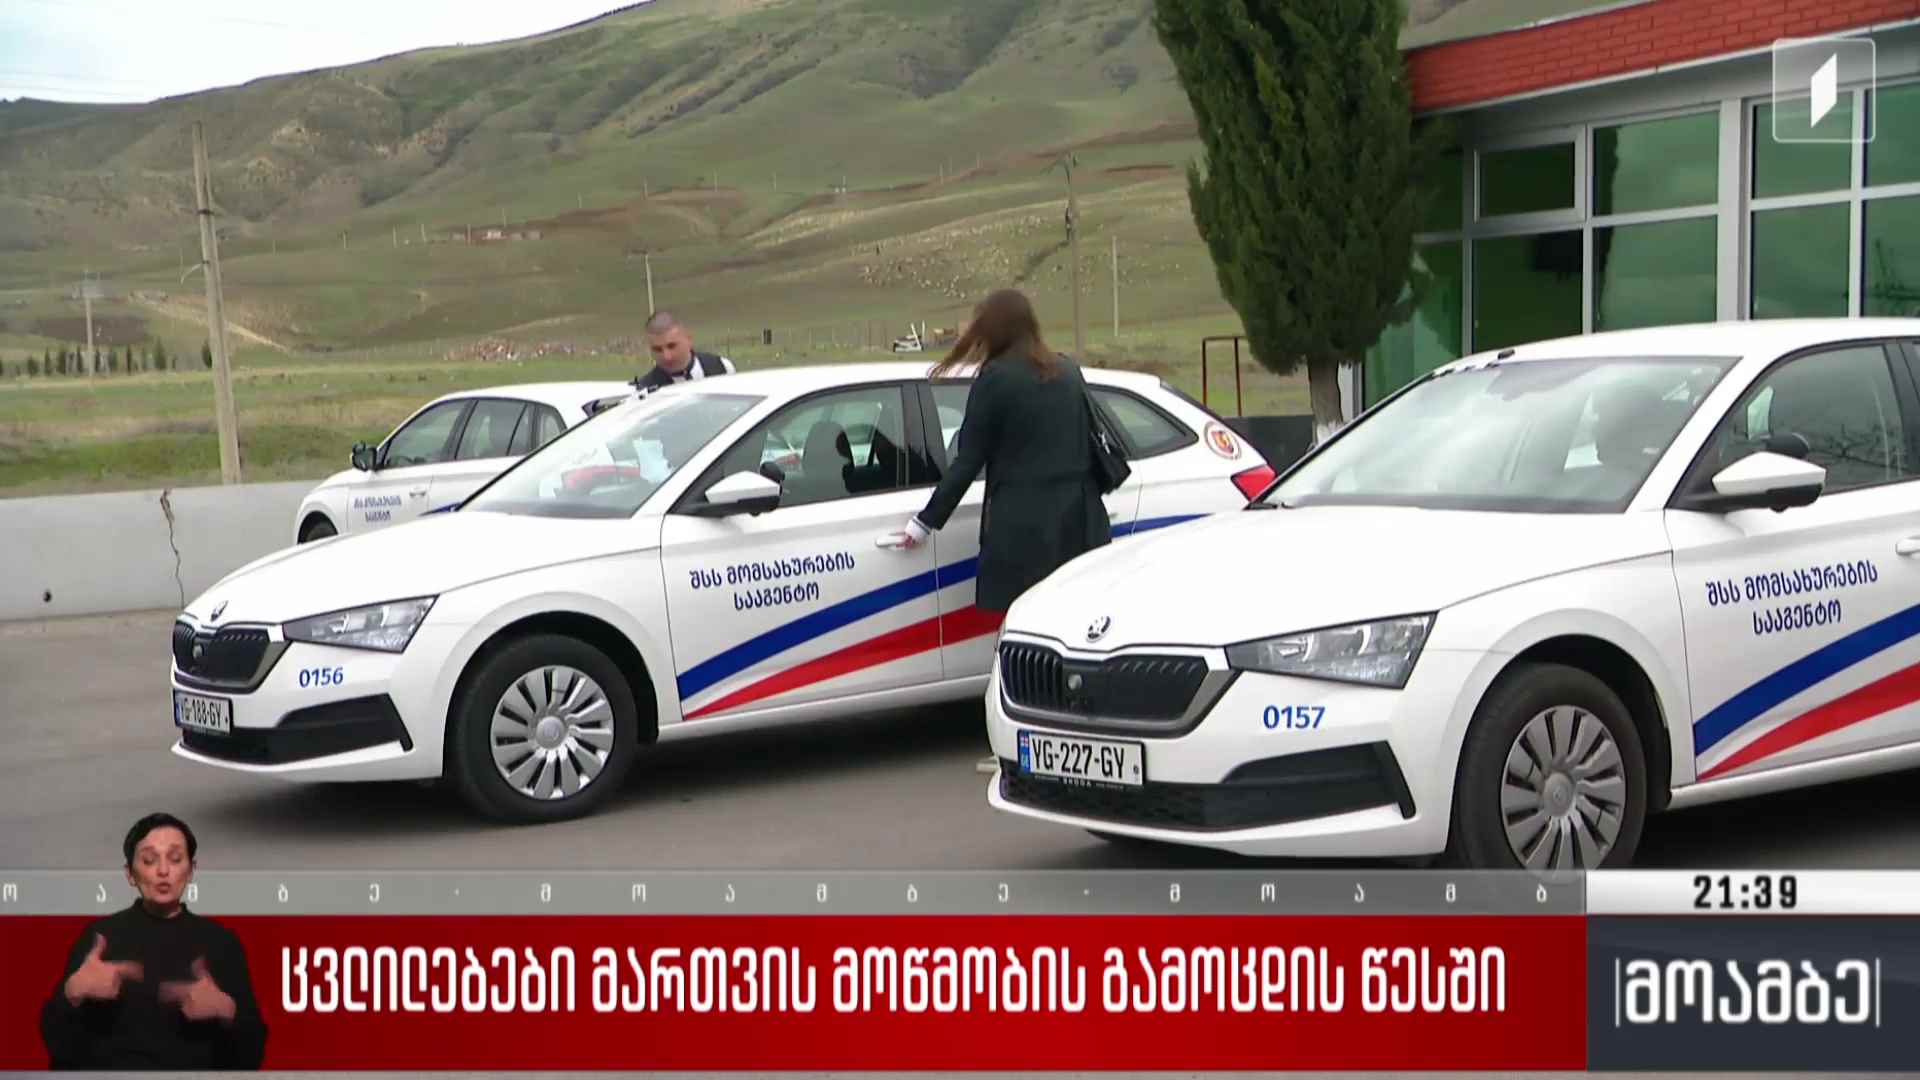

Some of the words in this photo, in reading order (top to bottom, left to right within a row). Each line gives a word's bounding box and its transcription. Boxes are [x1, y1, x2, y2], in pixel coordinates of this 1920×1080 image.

[689, 568, 722, 590] შსს
[727, 551, 856, 585] მომსახურების
[1705, 578, 1741, 606] შსს
[1744, 559, 1878, 601] მომსახურების
[733, 581, 820, 611] სააგენტო
[1753, 599, 1842, 635] სააგენტო
[299, 667, 344, 688] 0156
[1263, 704, 1326, 730] 0157
[1032, 737, 1125, 779] YG-227-GY
